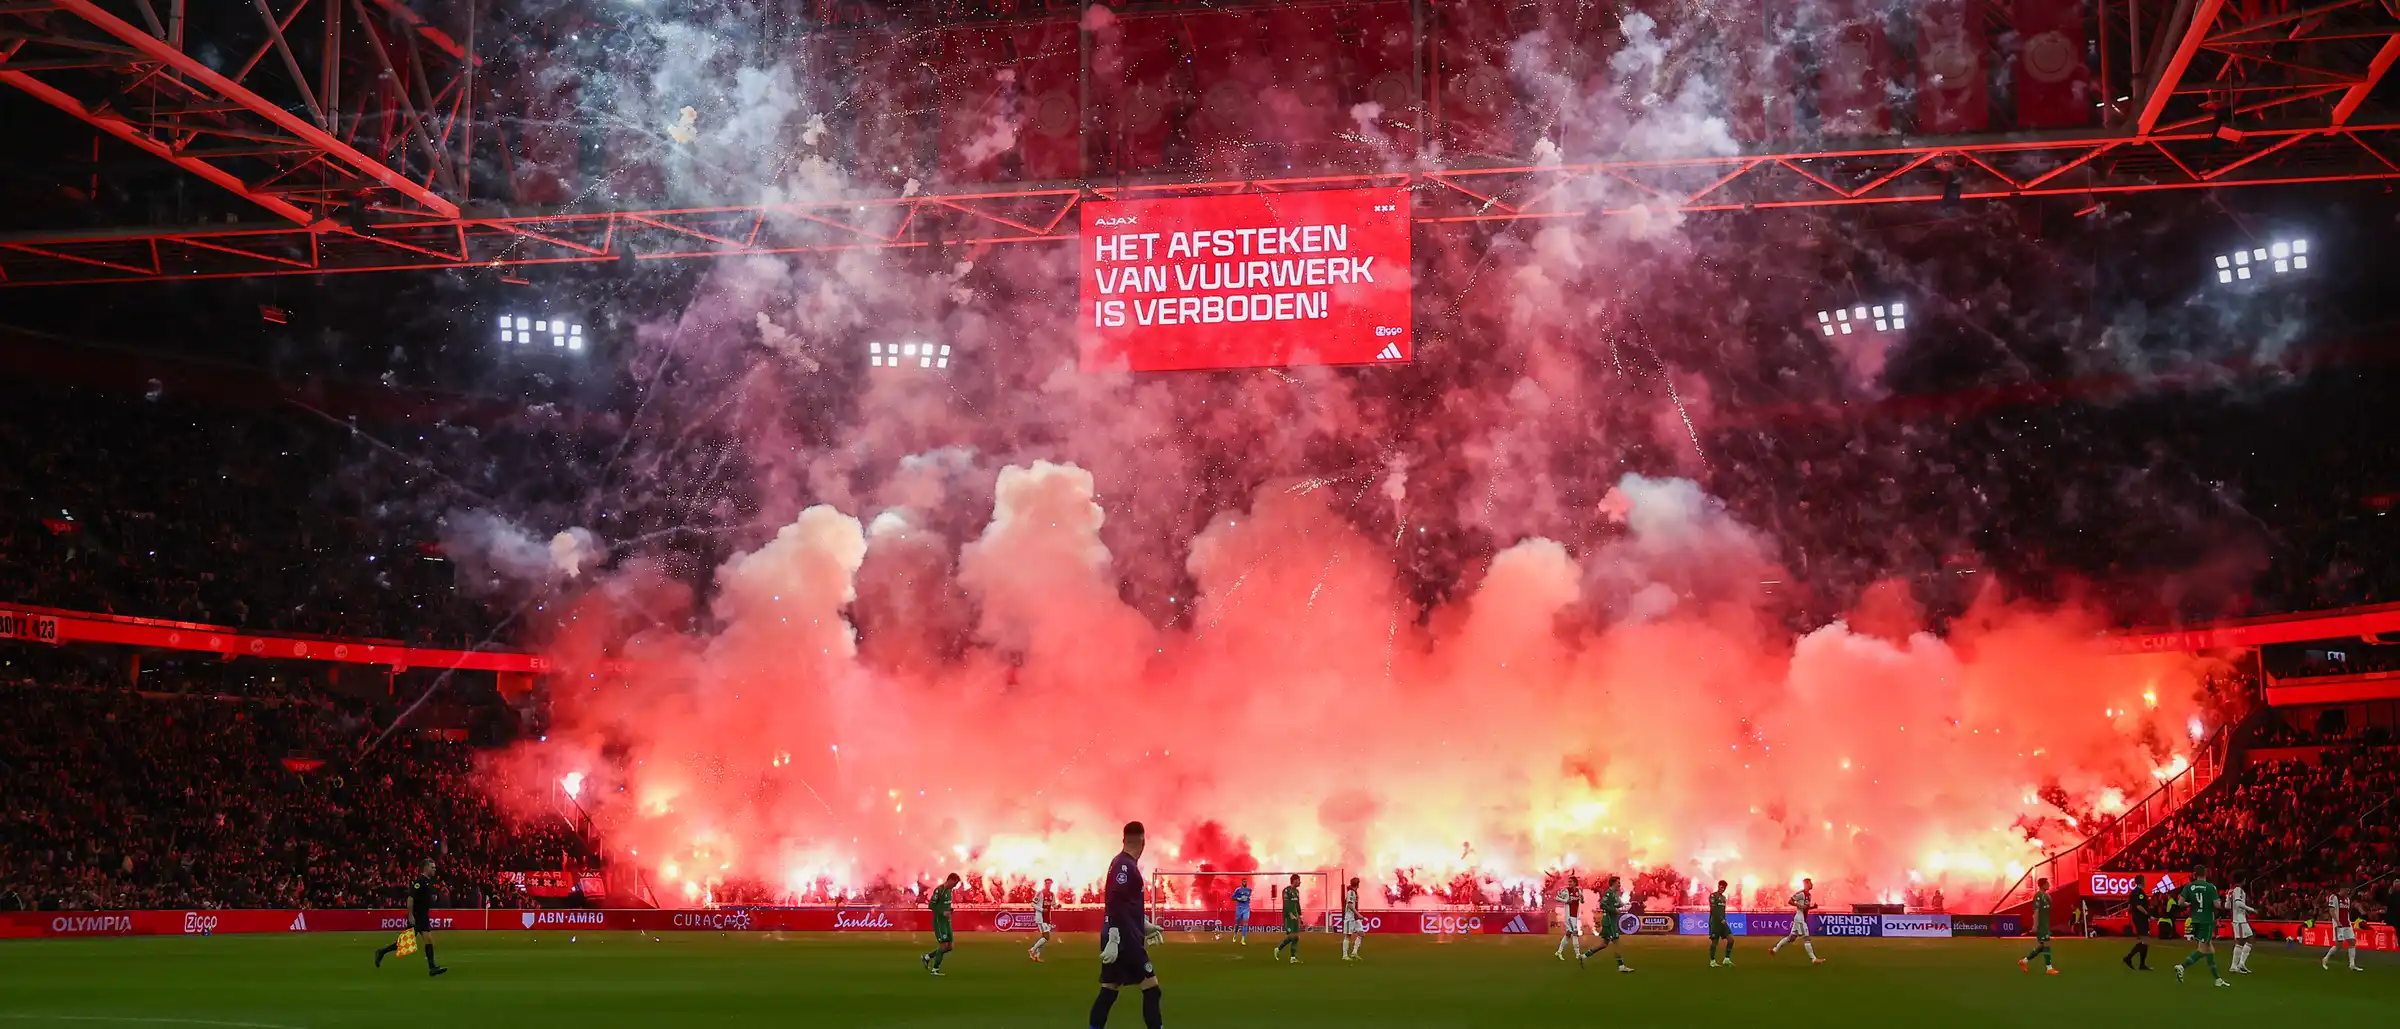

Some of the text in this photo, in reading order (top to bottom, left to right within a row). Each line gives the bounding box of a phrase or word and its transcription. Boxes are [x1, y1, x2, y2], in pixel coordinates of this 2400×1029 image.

[1095, 216, 1138, 226] AJAX
[1096, 224, 1347, 261] HET AFSTEKEN
[1095, 256, 1375, 294] VAN VUURWERK
[1096, 291, 1329, 328] IS VERBODEN!
[2195, 892, 2203, 909] 4
[52, 916, 132, 932] OLYMPIA
[381, 918, 453, 928] ROCKRS IT
[834, 911, 893, 928] Sandals
[1818, 915, 1878, 925] VRIENDEN
[1953, 920, 1988, 930] Heineken
[1826, 925, 1871, 935] LOTERIJ
[1884, 922, 1949, 932] OLYMPIA
